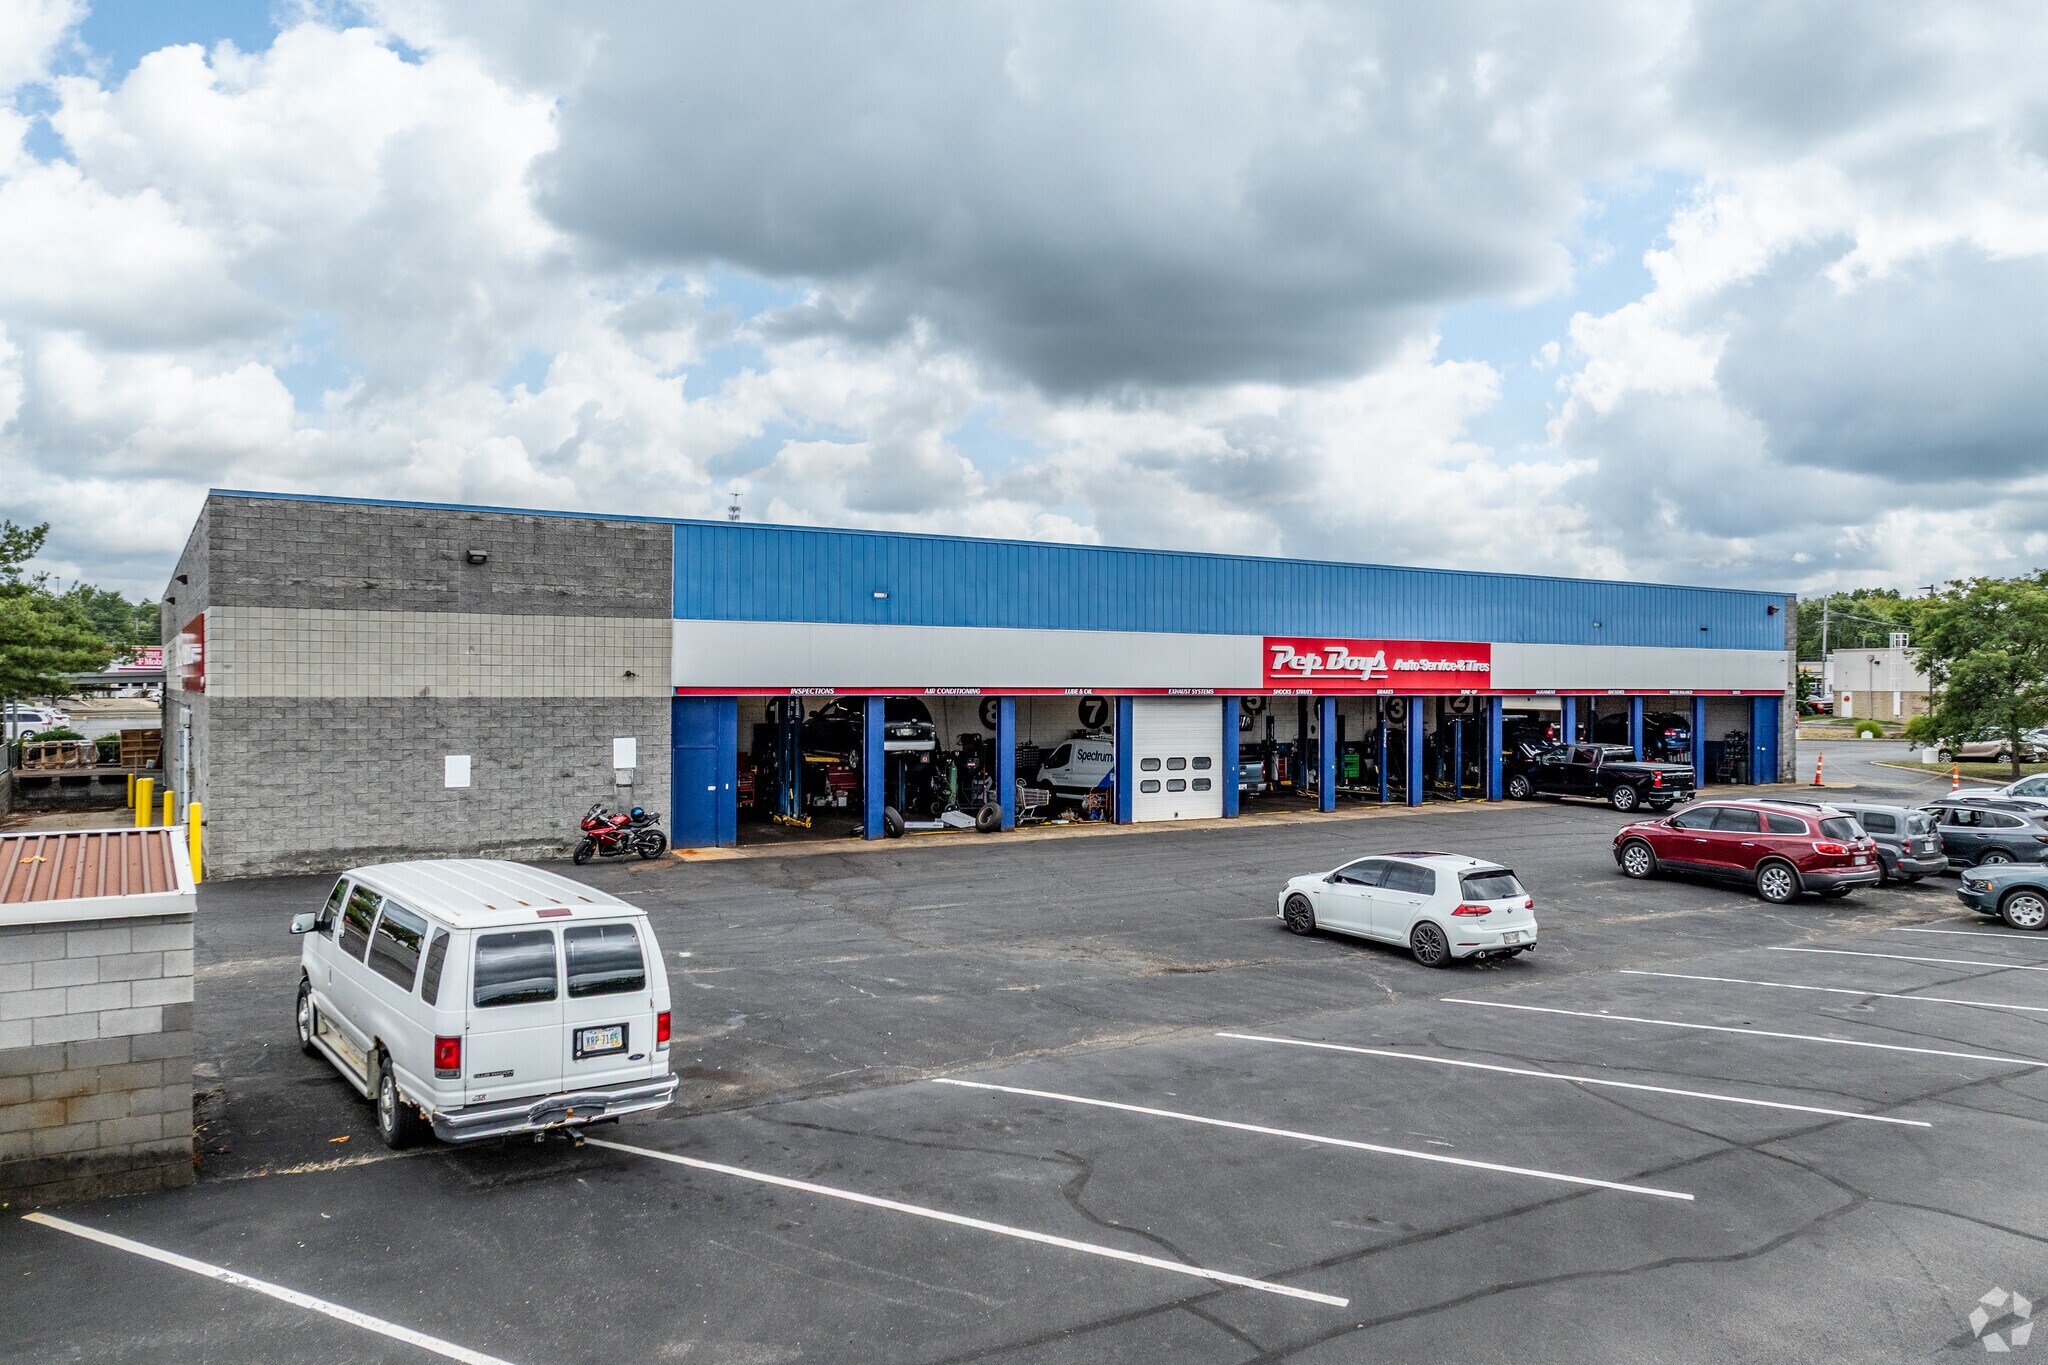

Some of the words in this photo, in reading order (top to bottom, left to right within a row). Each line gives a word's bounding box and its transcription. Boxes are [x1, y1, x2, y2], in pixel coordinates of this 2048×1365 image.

[136, 657, 163, 666] T-Mob
[1270, 645, 1324, 676] Pep
[1324, 646, 1388, 681] Boys
[1392, 658, 1420, 671] Auto
[1420, 658, 1456, 671] Service
[1465, 660, 1490, 672] Tires
[790, 687, 834, 695] INSPECTIONS
[1085, 700, 1102, 723] 7
[1390, 698, 1404, 719] 3
[1077, 749, 1114, 763] Spectrum
